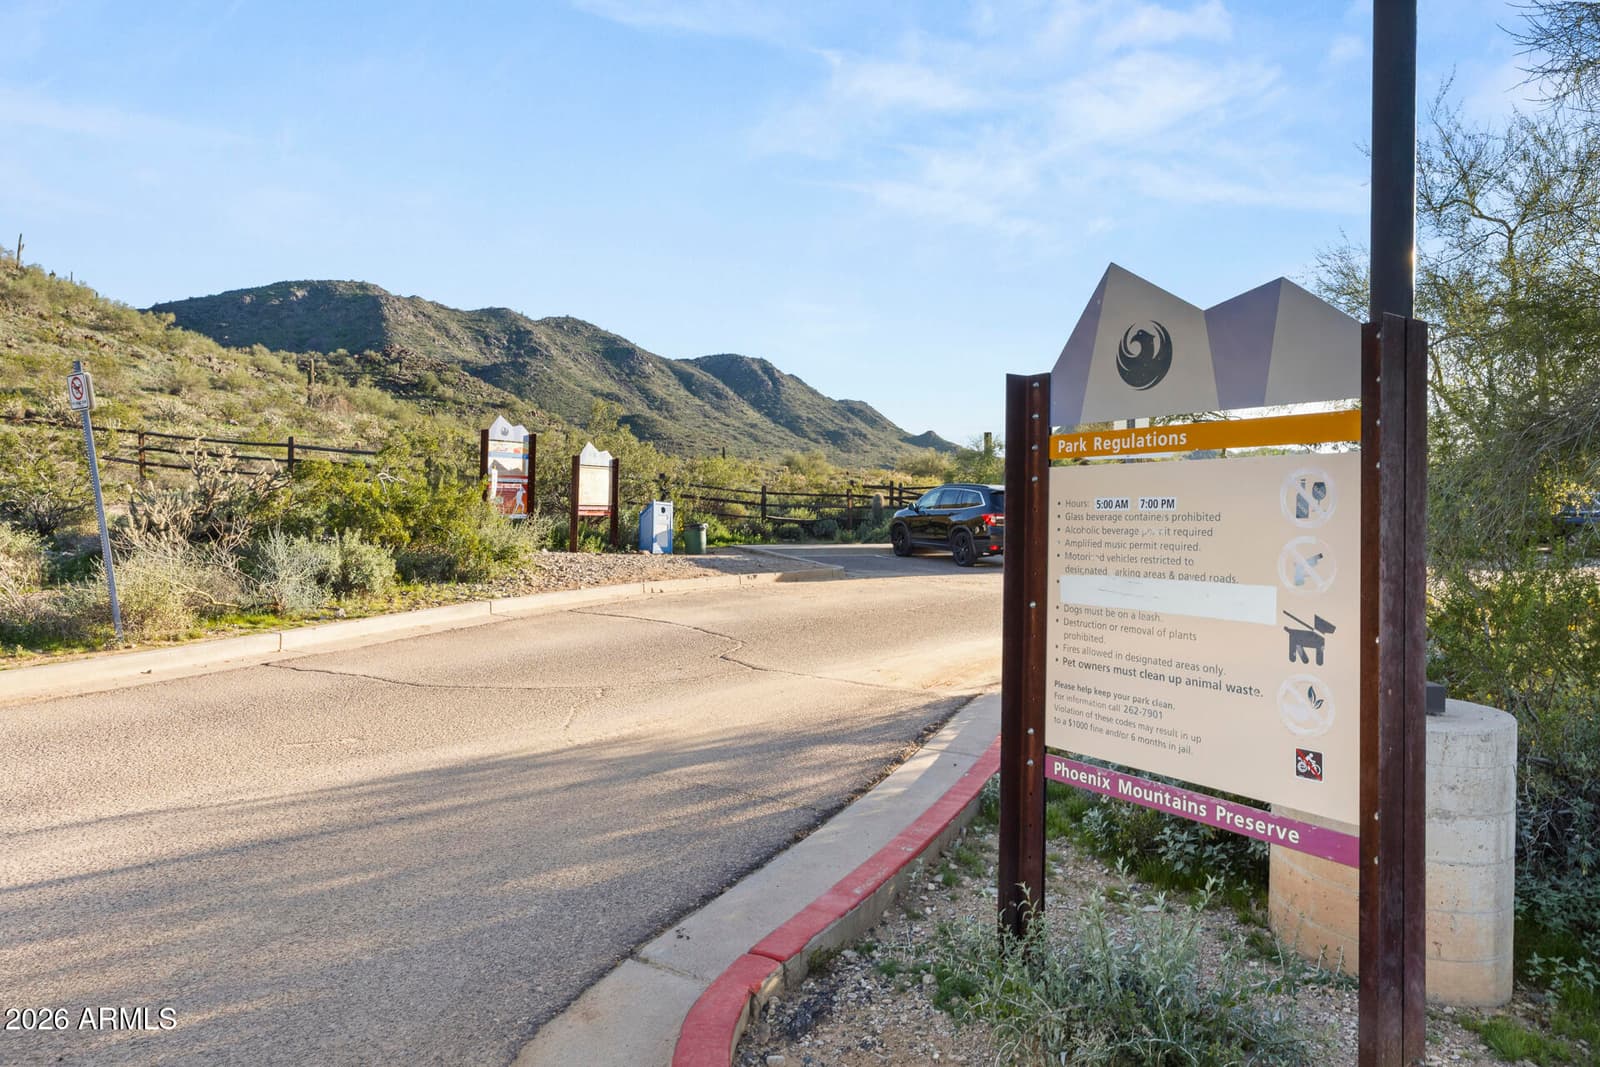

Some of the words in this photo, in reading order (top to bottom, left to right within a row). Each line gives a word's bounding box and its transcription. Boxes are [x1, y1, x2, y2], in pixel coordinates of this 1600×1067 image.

[1058, 437, 1087, 453] Park
[1094, 431, 1187, 453] Regulations
[1096, 499, 1113, 509] 5:00
[1115, 499, 1129, 509] AM
[1140, 498, 1159, 509] 7:00
[1161, 498, 1175, 509] PM
[1065, 512, 1084, 521] Glass
[1086, 513, 1121, 523] beverage
[1171, 512, 1221, 523] prohibited
[1065, 526, 1100, 535] Alcoholic
[1102, 527, 1139, 537] beverage
[1173, 527, 1213, 538] required
[1064, 539, 1102, 550] Amplified
[1104, 541, 1127, 550] music
[1129, 541, 1157, 551] permit
[1107, 553, 1138, 564] vehicles
[1140, 555, 1182, 566] restricted
[1184, 557, 1194, 566] to
[1143, 570, 1166, 580] areas
[1168, 570, 1175, 580] &
[1209, 573, 1240, 584] roads.
[1063, 604, 1082, 616] Dogs
[1084, 607, 1103, 617] must
[1105, 607, 1116, 618] be
[1118, 610, 1129, 619] on
[1063, 618, 1107, 630] Destruction
[1109, 623, 1118, 632] or
[1120, 625, 1154, 636] removal
[1156, 627, 1167, 637] of
[1168, 629, 1197, 641] plants
[1063, 644, 1080, 654] Fires
[1082, 647, 1113, 659] allowed
[1115, 650, 1123, 660] in
[1125, 652, 1173, 667] designated
[1175, 661, 1200, 671] areas
[1202, 664, 1227, 677] only.
[1062, 656, 1076, 667] Pet
[1078, 661, 1111, 673] owners
[1113, 665, 1137, 677] must
[1139, 668, 1165, 681] clean
[1168, 675, 1182, 686] up
[1185, 676, 1222, 691] animal
[1225, 683, 1264, 697] waste.
[1054, 680, 1075, 690] Please
[1077, 683, 1092, 695] help
[1094, 687, 1111, 698] keep
[1113, 692, 1130, 701] your
[1132, 696, 1150, 705] park
[1054, 692, 1065, 700] For
[1066, 695, 1107, 710] information
[1108, 703, 1120, 713] call
[1123, 704, 1163, 720] 262-7901
[1053, 716, 1061, 725] to
[1068, 718, 1089, 731] $1000
[1138, 735, 1167, 749] months
[1168, 742, 1176, 751] in
[1054, 703, 1084, 717] Violation
[1085, 711, 1093, 719] of
[1095, 712, 1114, 723] these
[1115, 717, 1136, 729] codes
[1138, 722, 1154, 734] may
[1156, 727, 1178, 739] result
[1180, 731, 1188, 740] in
[1191, 734, 1202, 744] up
[1053, 761, 1111, 790] Phoenix
[1118, 778, 1208, 817] Mountains
[1216, 804, 1300, 844] Preserve
